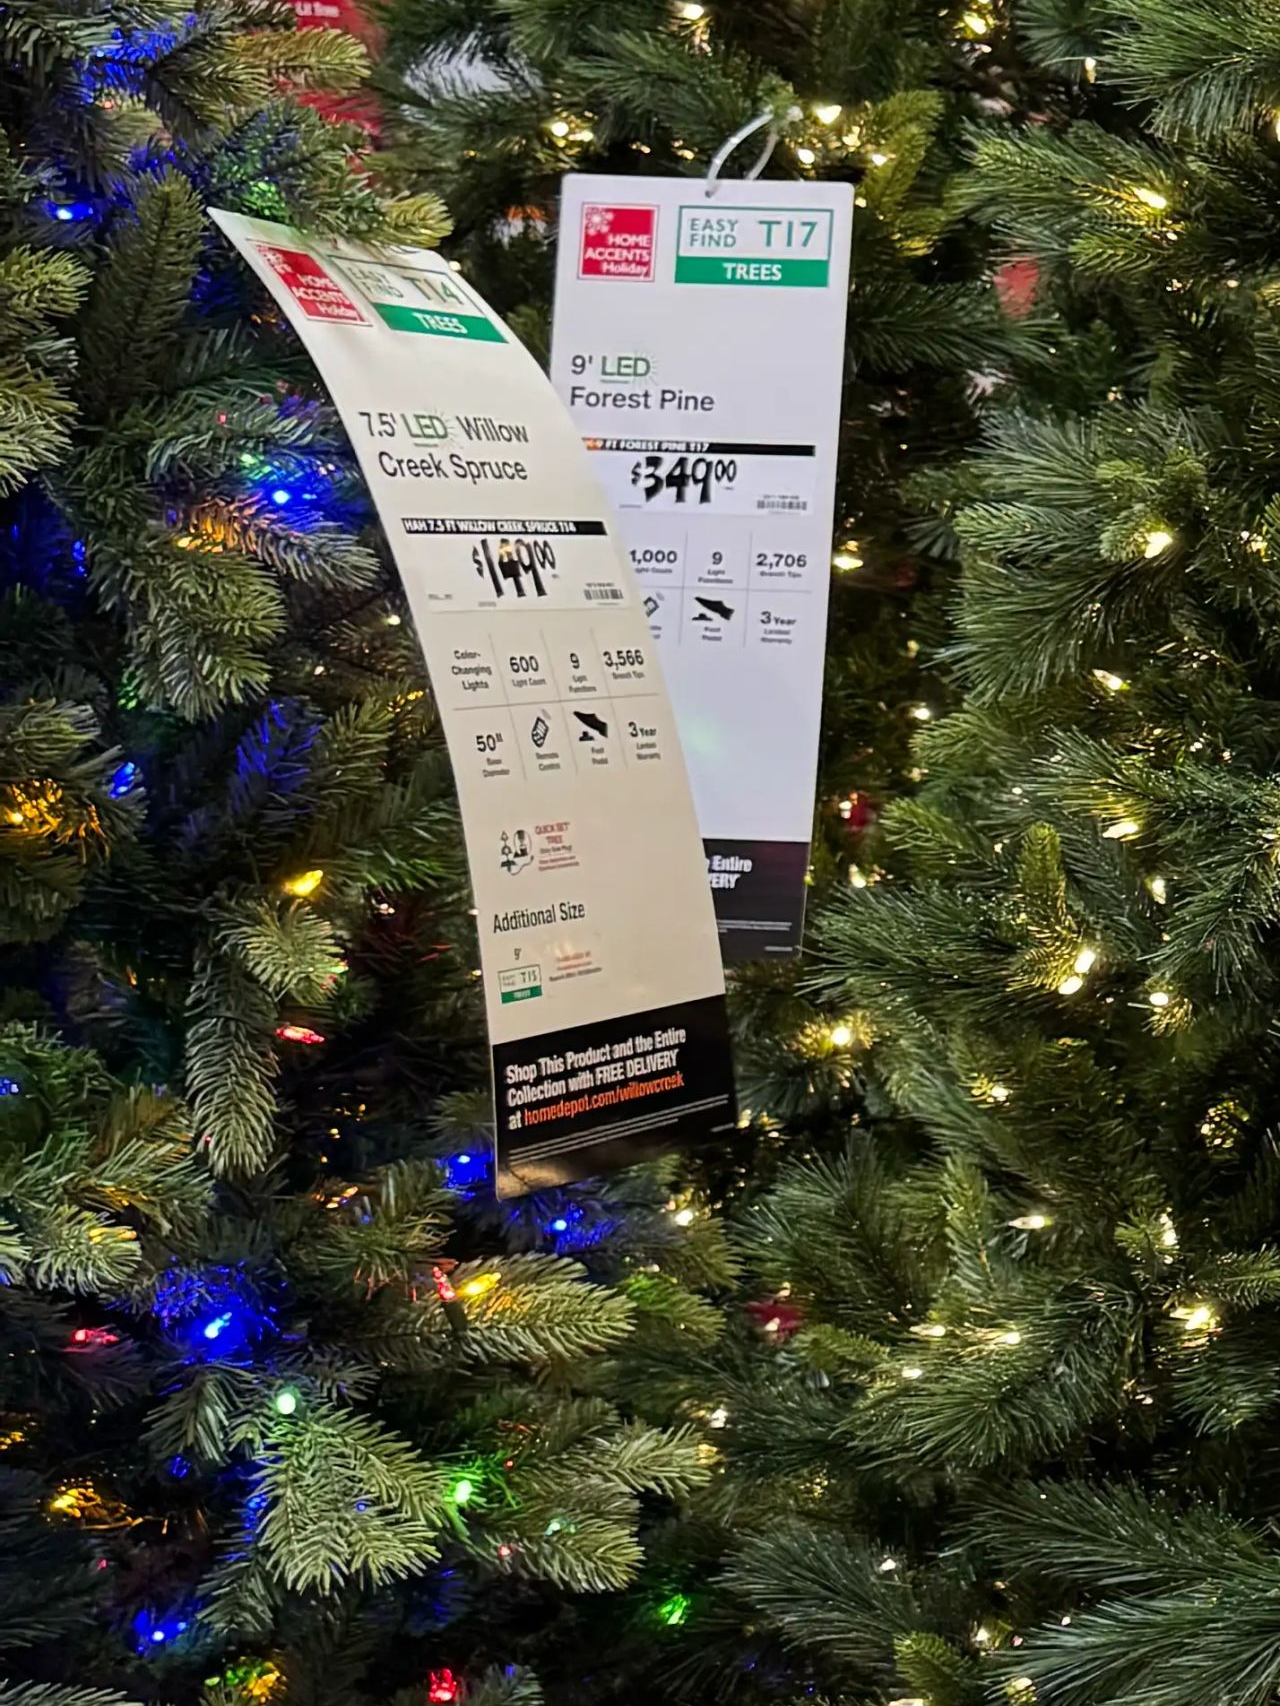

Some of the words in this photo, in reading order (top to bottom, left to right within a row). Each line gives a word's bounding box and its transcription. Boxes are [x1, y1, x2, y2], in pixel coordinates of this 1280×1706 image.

[608, 233, 653, 248] HOME
[690, 218, 738, 233] EASY
[758, 219, 819, 249] T17
[690, 232, 737, 249] FIND
[584, 247, 651, 263] ACCENTS
[601, 261, 651, 279] Holiday
[722, 261, 783, 282] TREES
[299, 273, 338, 291] HOME
[402, 275, 465, 306] T14
[412, 311, 469, 335] TREES
[570, 354, 594, 377] 9'
[600, 355, 652, 379] LED
[568, 385, 653, 410] Forest
[658, 388, 717, 413] Pine
[358, 411, 398, 439] 7.5'
[400, 412, 450, 440] LED
[455, 415, 530, 444] Willow
[377, 450, 450, 479] Creek
[450, 452, 529, 486] Spruce
[456, 520, 497, 533] WILLOW
[628, 548, 679, 566] 1,000
[711, 550, 724, 566] 9
[755, 552, 808, 570] 2,706
[760, 610, 772, 626] 3
[773, 616, 797, 627] Year
[509, 654, 540, 674] 600
[569, 652, 581, 670] 9
[602, 649, 645, 671] 3,566
[451, 664, 493, 677] Changing
[462, 680, 490, 692] Lights
[628, 720, 639, 738] 3
[639, 727, 657, 738] Year
[475, 732, 504, 753] 50"
[711, 855, 753, 873] Entire
[492, 903, 557, 934] Additional
[559, 901, 586, 923] Size
[505, 1063, 538, 1085] Shop
[539, 1054, 565, 1077] This
[565, 1043, 611, 1071] Product
[612, 1037, 634, 1060] and
[635, 1033, 654, 1053] the
[654, 1026, 687, 1049] Entire
[507, 1080, 566, 1108] Collection
[568, 1071, 594, 1094] with
[595, 1064, 625, 1086] FREE
[508, 1112, 523, 1131] at
[523, 1070, 686, 1127] homedepot.com/willowcreek
